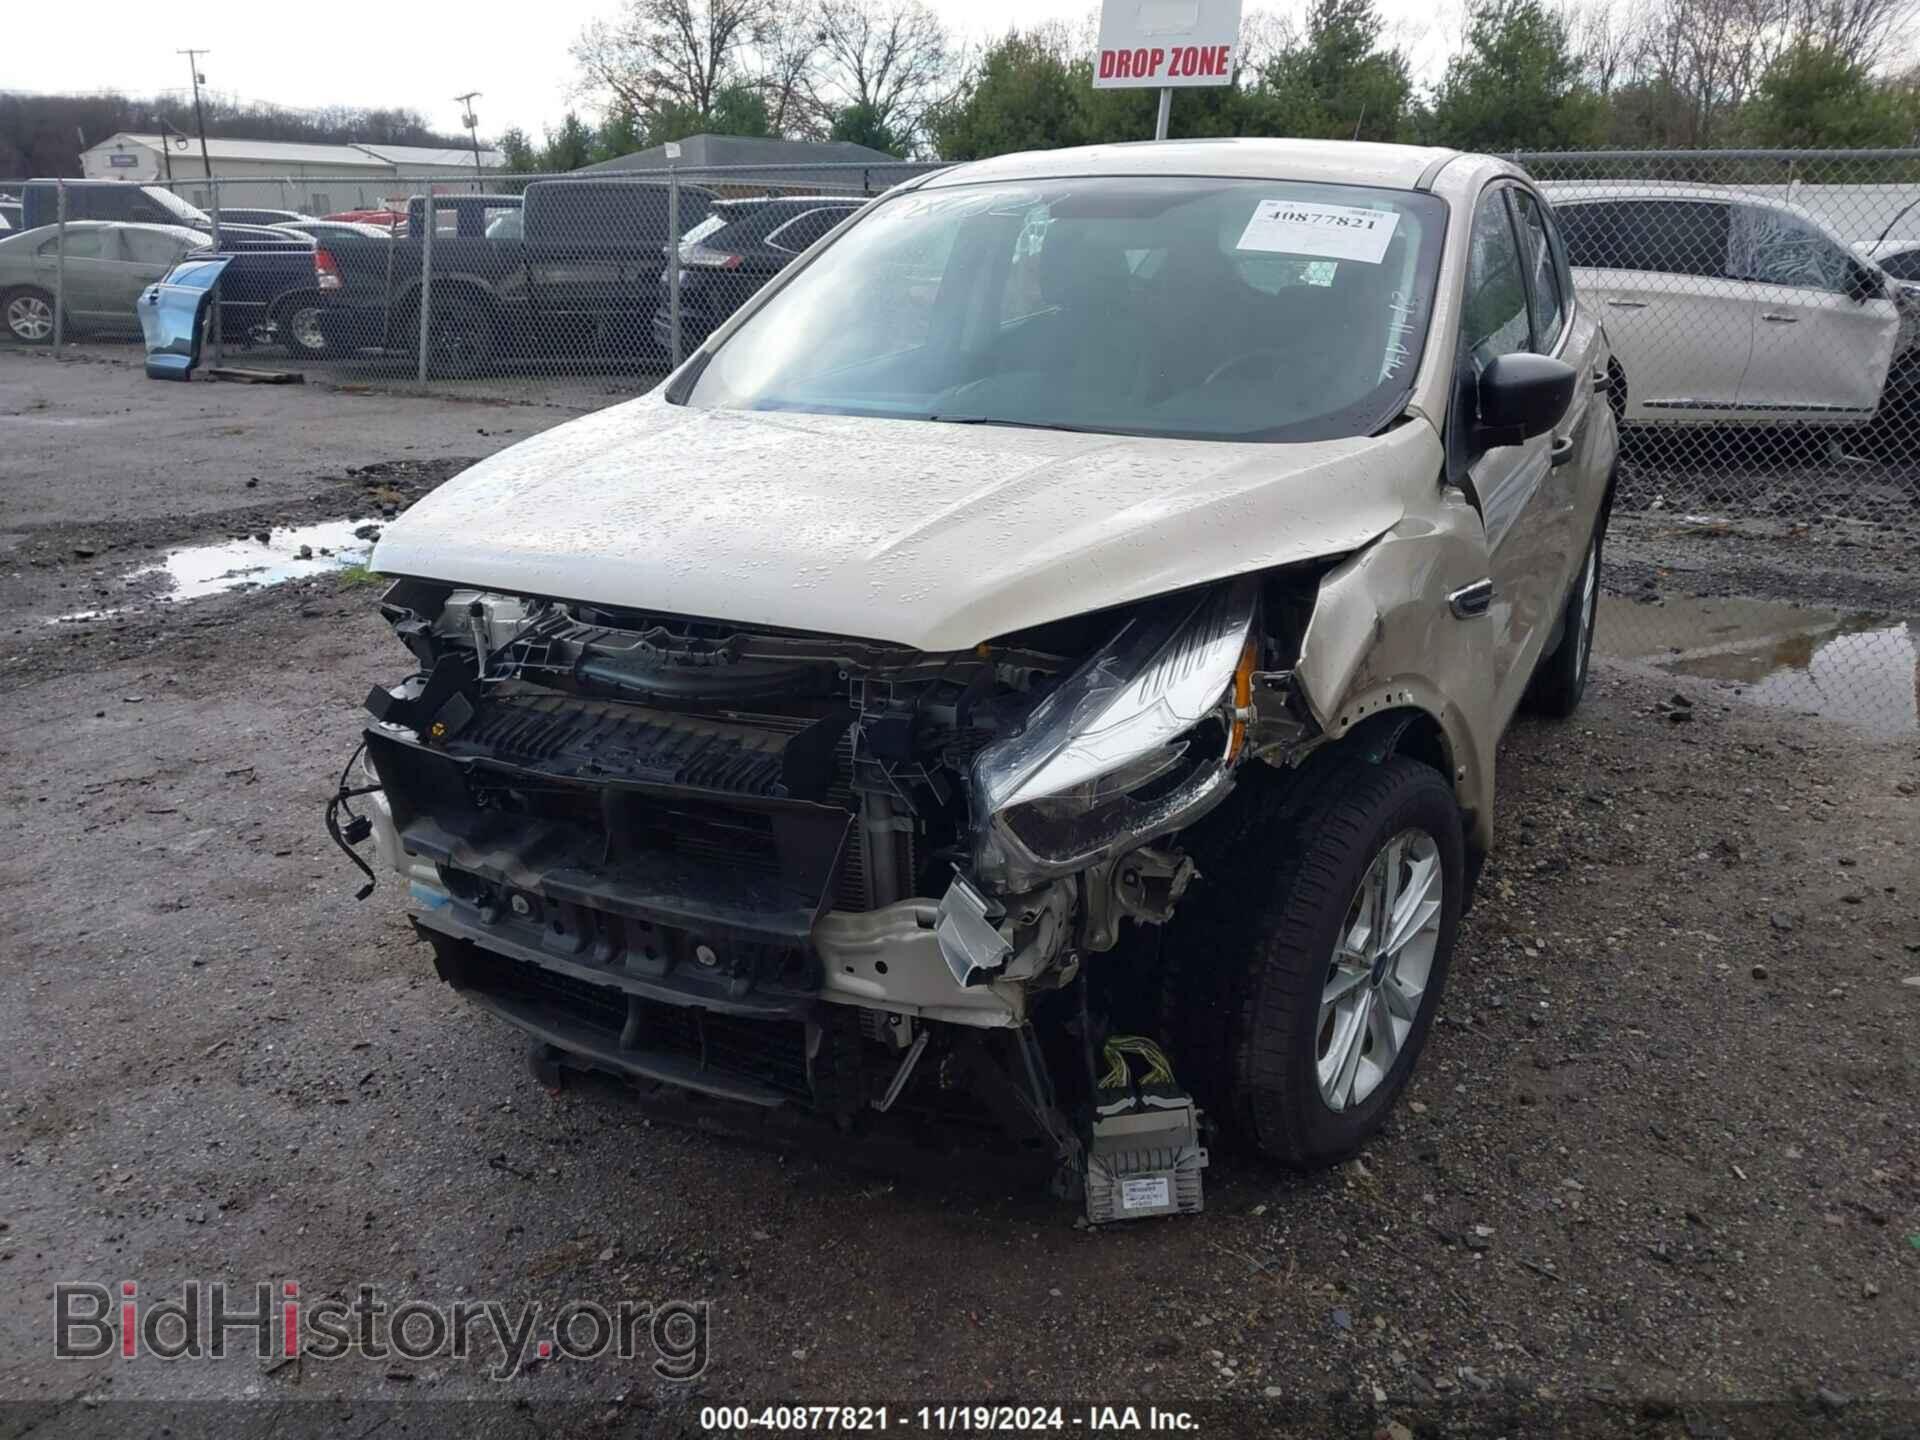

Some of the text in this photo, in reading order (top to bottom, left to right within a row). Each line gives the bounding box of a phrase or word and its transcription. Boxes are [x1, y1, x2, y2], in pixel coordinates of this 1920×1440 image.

[1099, 45, 1231, 78] DROP ZONE
[1267, 211, 1375, 230] 40877821
